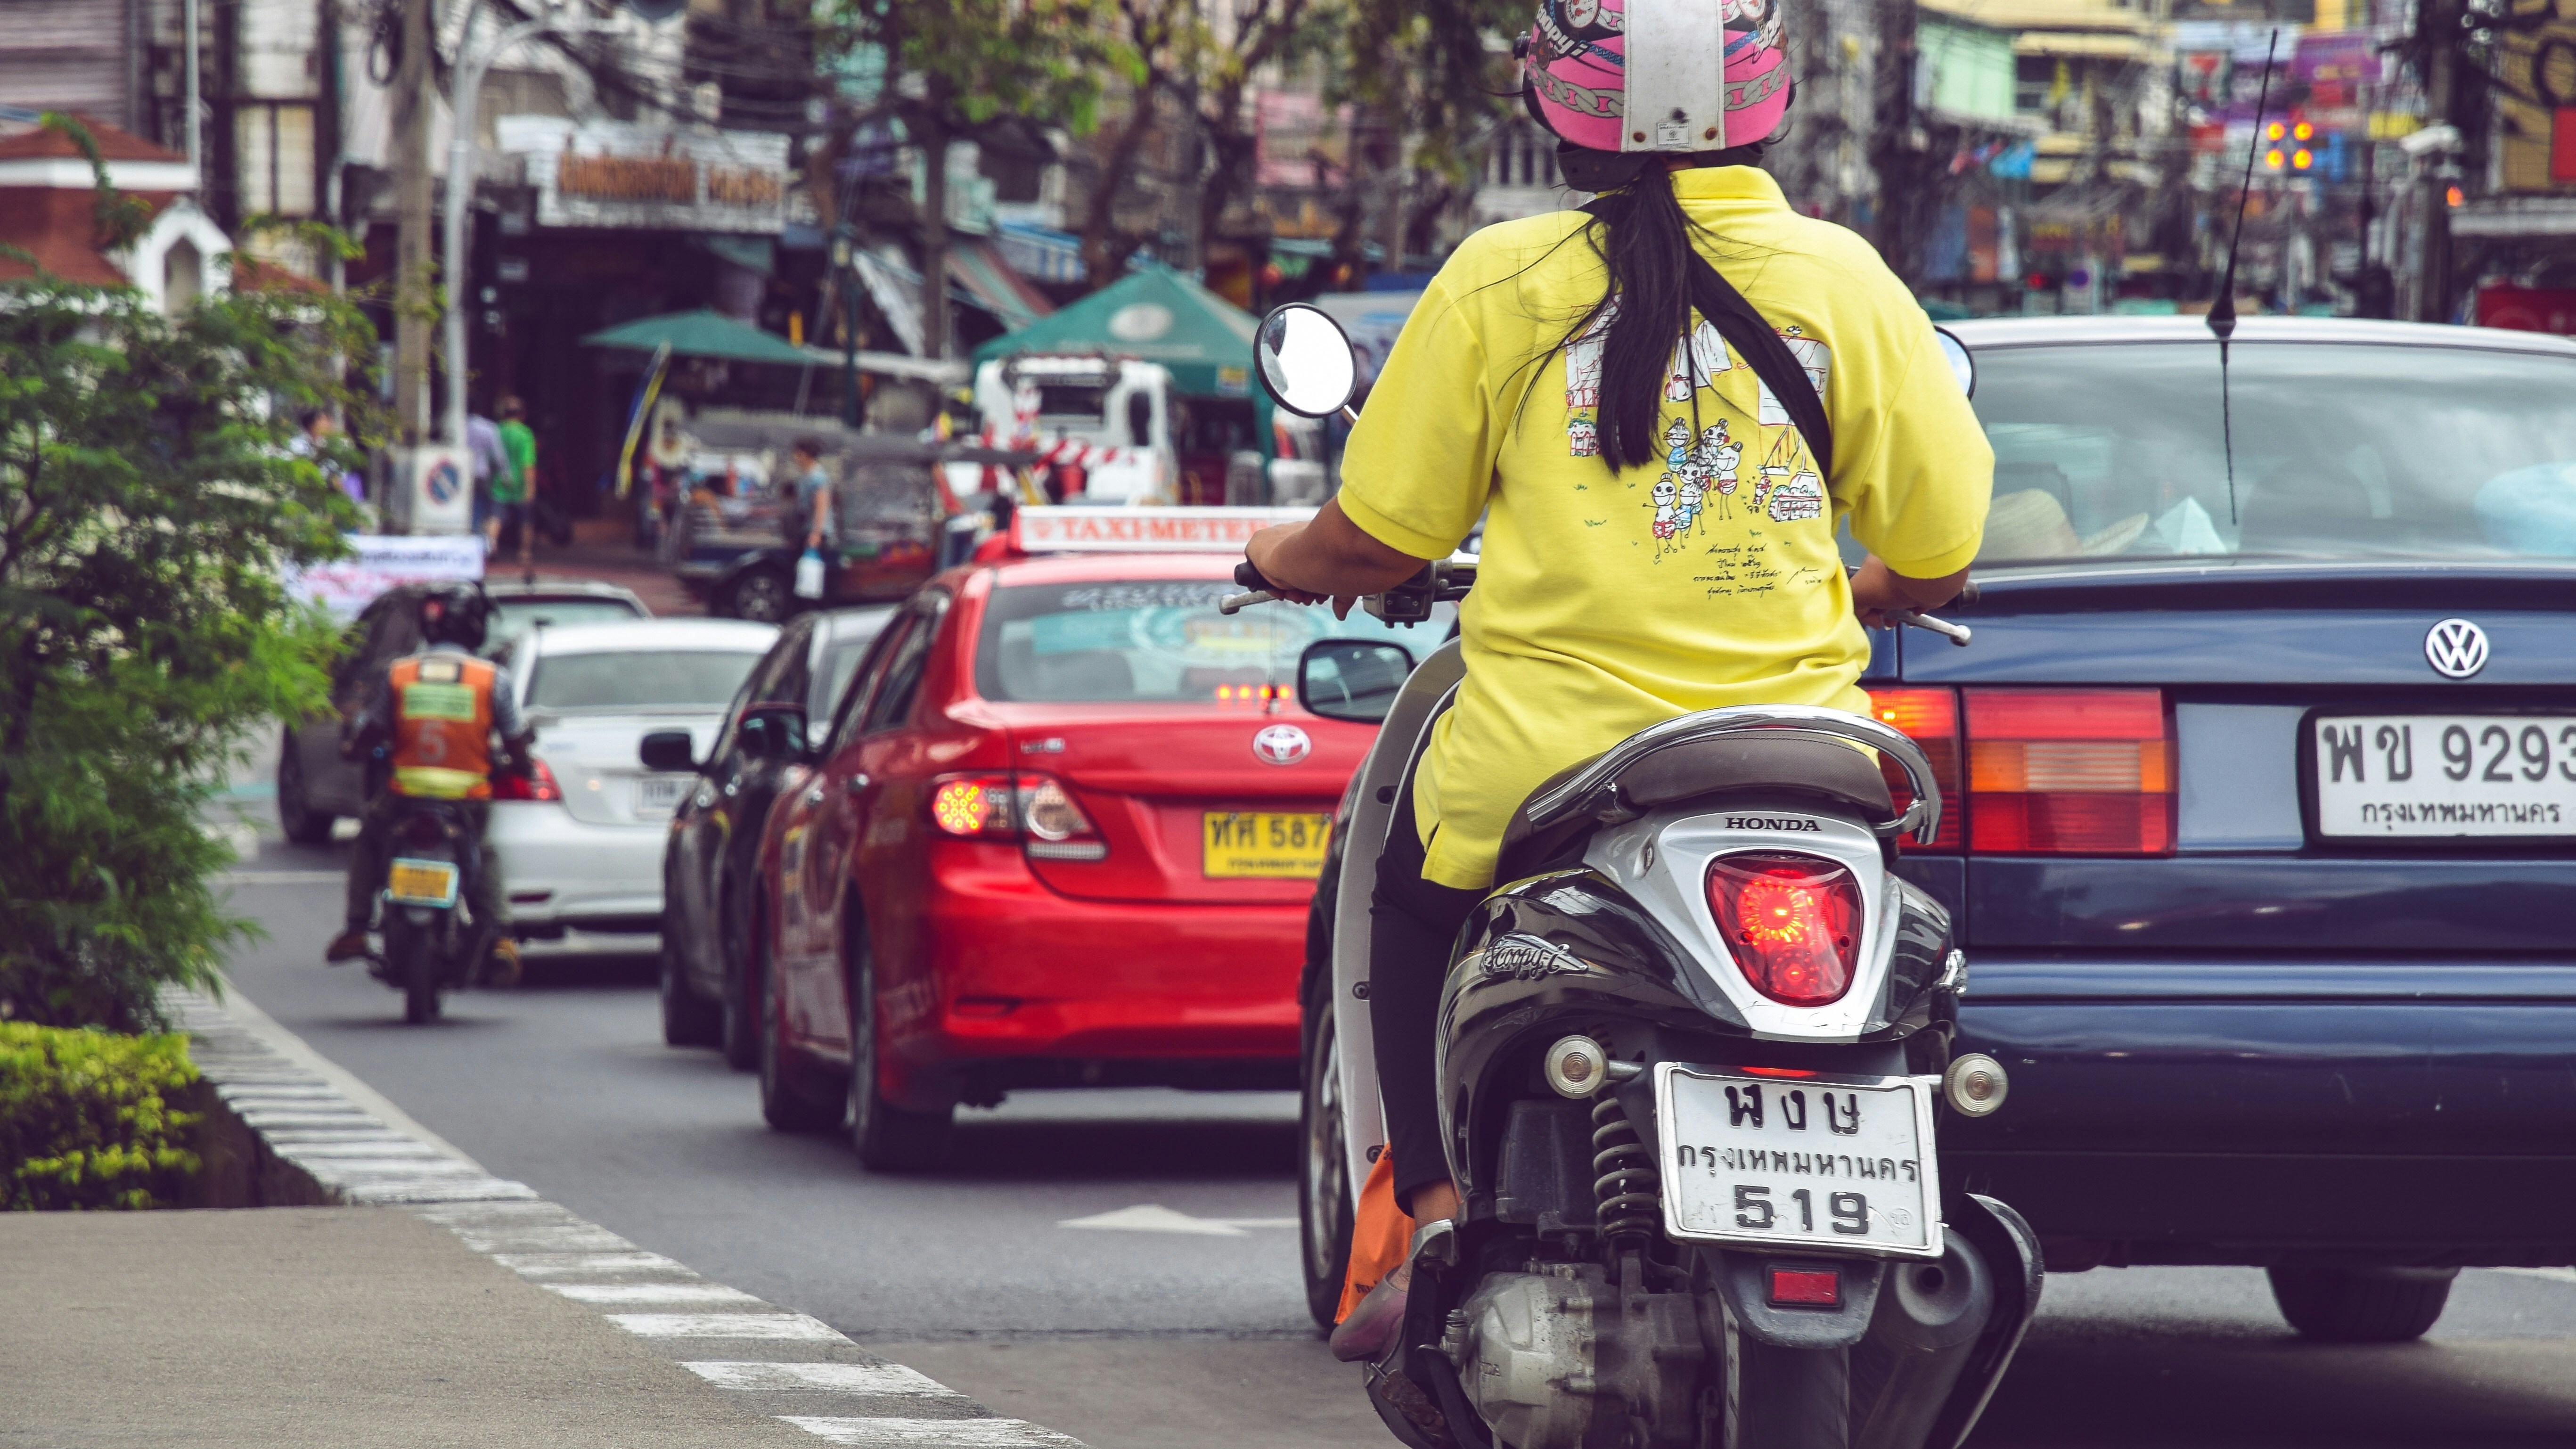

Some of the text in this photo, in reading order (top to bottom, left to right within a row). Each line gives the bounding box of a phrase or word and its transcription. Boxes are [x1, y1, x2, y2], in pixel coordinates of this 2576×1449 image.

[417, 718, 447, 763] 5
[2441, 724, 2576, 783] 9293
[1725, 817, 1822, 832] HONDA
[2362, 802, 2560, 831] กรุงเทพมหานคร
[1678, 1144, 1919, 1182] กรุงเทพมหานคร
[1734, 1185, 1869, 1235] 519
